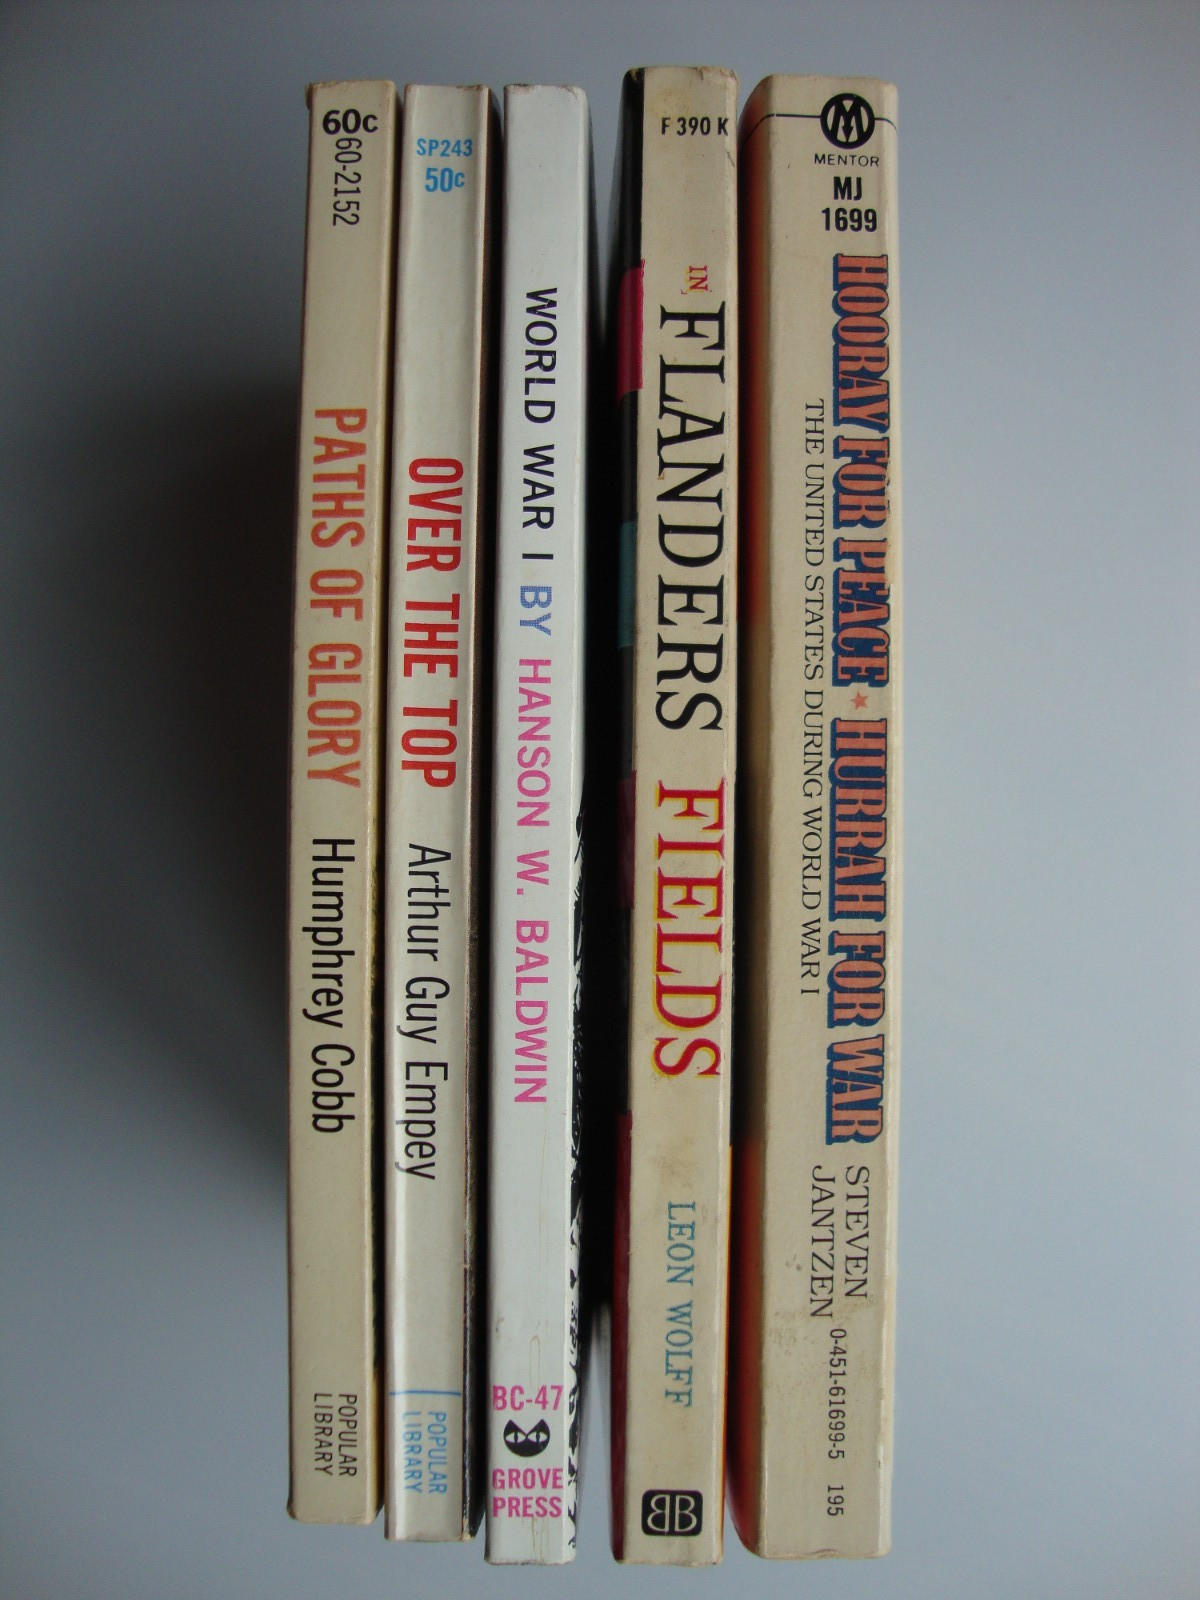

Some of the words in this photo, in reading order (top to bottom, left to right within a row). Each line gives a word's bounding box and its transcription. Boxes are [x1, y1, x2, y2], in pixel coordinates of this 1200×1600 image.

[416, 138, 473, 157] SP243
[660, 117, 671, 136] F
[676, 116, 711, 136] 390
[717, 117, 729, 136] K
[814, 152, 880, 168] MENTOR
[332, 136, 363, 227] 60-2152
[821, 207, 878, 232] 1699
[833, 176, 863, 201] MJ
[685, 265, 709, 293] IN
[524, 287, 558, 424] WORLD
[831, 252, 890, 434] HOORAY
[804, 399, 825, 455] THE
[310, 407, 368, 549] PATHS
[406, 457, 464, 572] OVER
[521, 443, 556, 530] WAR
[655, 301, 726, 731] FLANDERS
[804, 464, 825, 567] UNITED
[831, 435, 891, 530] FOR
[309, 568, 365, 622] OF
[521, 552, 555, 561] I
[403, 593, 460, 679] THE
[519, 585, 553, 637] BY
[803, 574, 825, 681] STATES
[831, 537, 891, 688] PEACE
[306, 643, 363, 789] GLORY
[401, 699, 458, 788] TOP
[516, 659, 552, 827] HANSON
[802, 689, 825, 799] DURING
[801, 806, 823, 911] WORLD
[828, 717, 888, 923] HURRAH
[406, 843, 452, 962] Arthur
[516, 849, 551, 896] W.
[301, 838, 356, 1029] Humphrey
[652, 776, 726, 1077] FIELDS
[800, 917, 822, 980] WAR
[396, 976, 450, 1044] Guy
[514, 920, 550, 1103] BALDWIN
[800, 987, 820, 996] I
[827, 930, 887, 1029] FOR
[311, 1043, 356, 1133] Cobb
[394, 1061, 449, 1180] Empey
[825, 1033, 886, 1146] WAR
[665, 1201, 696, 1287] LEON
[809, 1164, 836, 1319] JANTZEN
[844, 1165, 870, 1300] STEVEN
[492, 1384, 563, 1411] BC-47
[664, 1301, 694, 1408] WOLFF
[827, 1328, 847, 1460] 0-451-61699-5
[313, 1393, 333, 1477] LIBRARY
[338, 1393, 357, 1477] POPULAR
[402, 1411, 422, 1494] LIBRARY
[427, 1411, 447, 1495] POPULAR
[492, 1467, 564, 1491] GROVE
[492, 1496, 562, 1518] PRESS
[826, 1484, 844, 1517] 195
